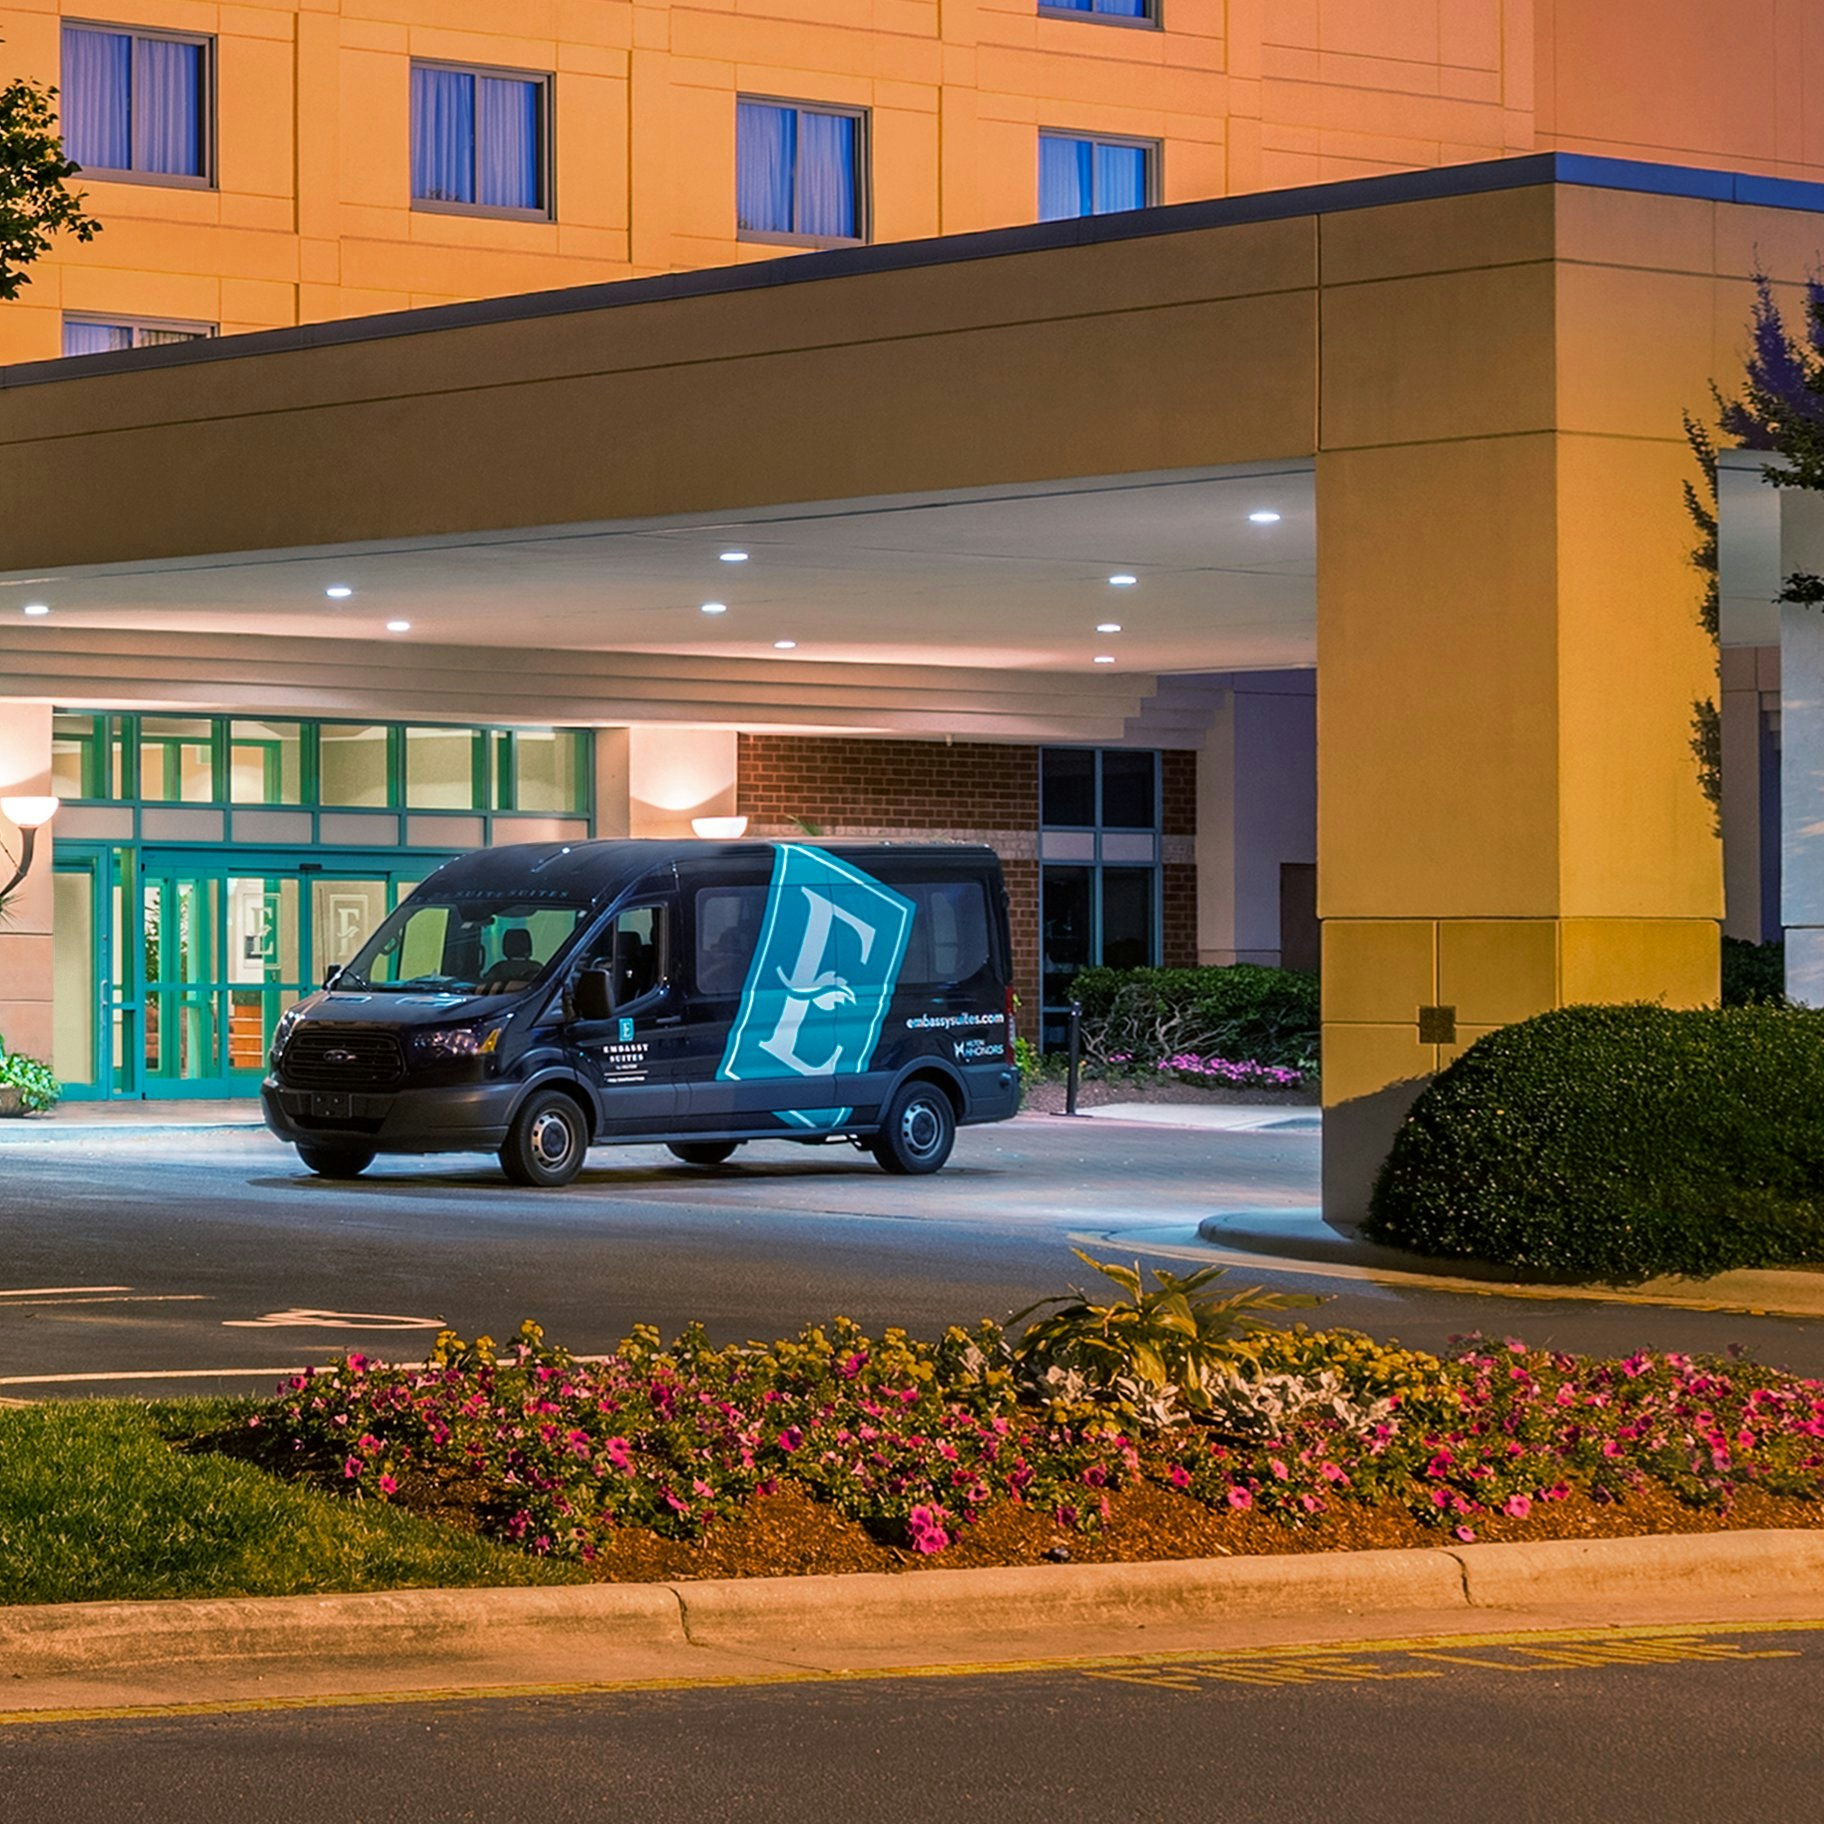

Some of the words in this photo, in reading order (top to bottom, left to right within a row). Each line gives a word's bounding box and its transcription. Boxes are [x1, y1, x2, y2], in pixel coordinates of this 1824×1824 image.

[759, 886, 876, 1077] E
[906, 1013, 1004, 1029] embassysuites.com
[603, 1044, 648, 1054] EMBASSY
[609, 1054, 644, 1063] SUITES
[1080, 1656, 1445, 1692] FIRE
[1407, 1636, 1804, 1672] LANE
